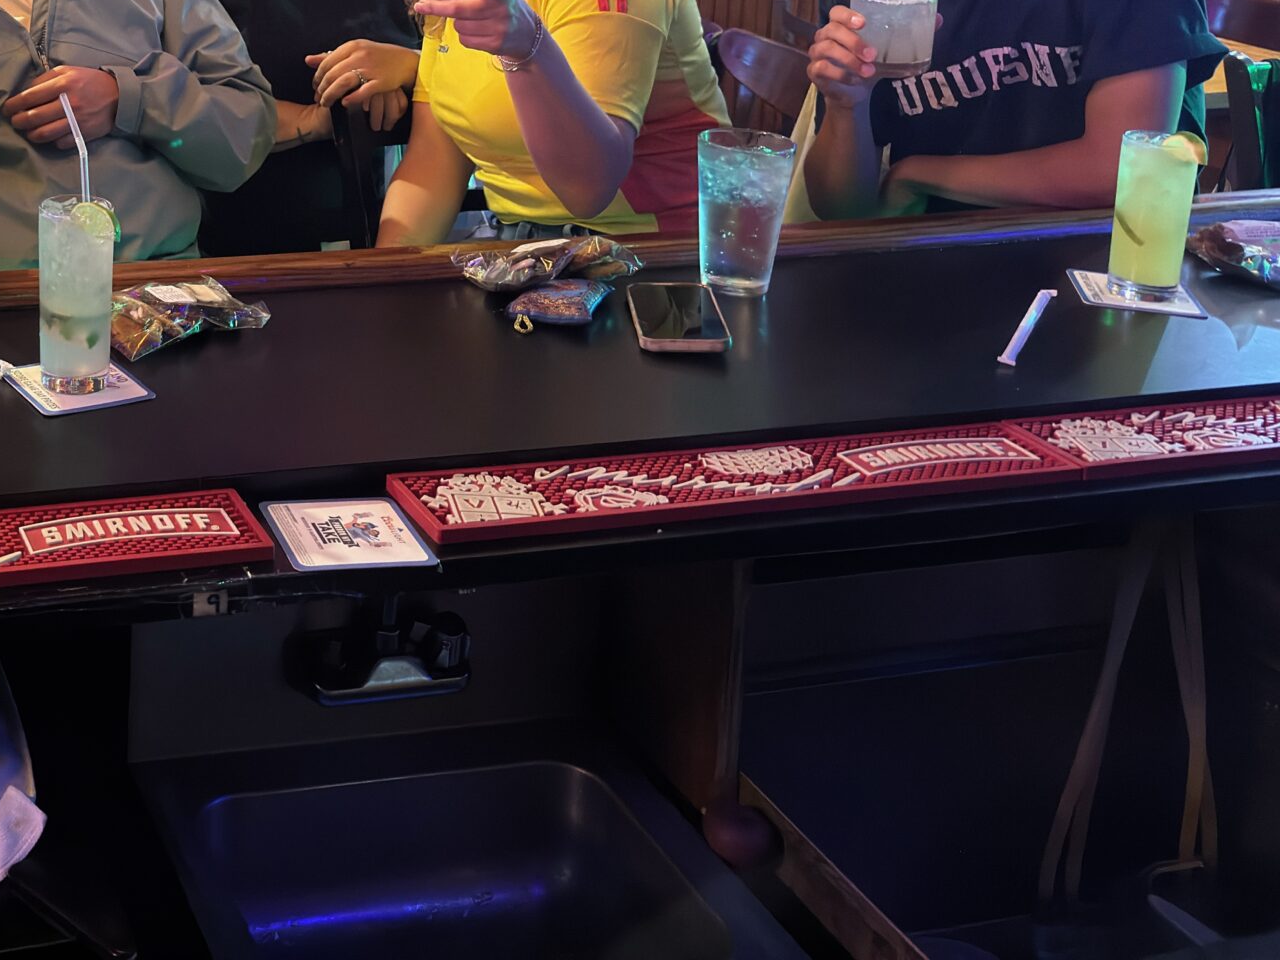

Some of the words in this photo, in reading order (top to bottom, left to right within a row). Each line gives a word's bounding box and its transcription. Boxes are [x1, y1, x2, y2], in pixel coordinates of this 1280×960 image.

[892, 42, 1083, 117] UQUESNE
[859, 441, 1006, 467] SMIRNOFF
[41, 513, 212, 545] SMIRNOFF
[317, 521, 341, 544] TAKE
